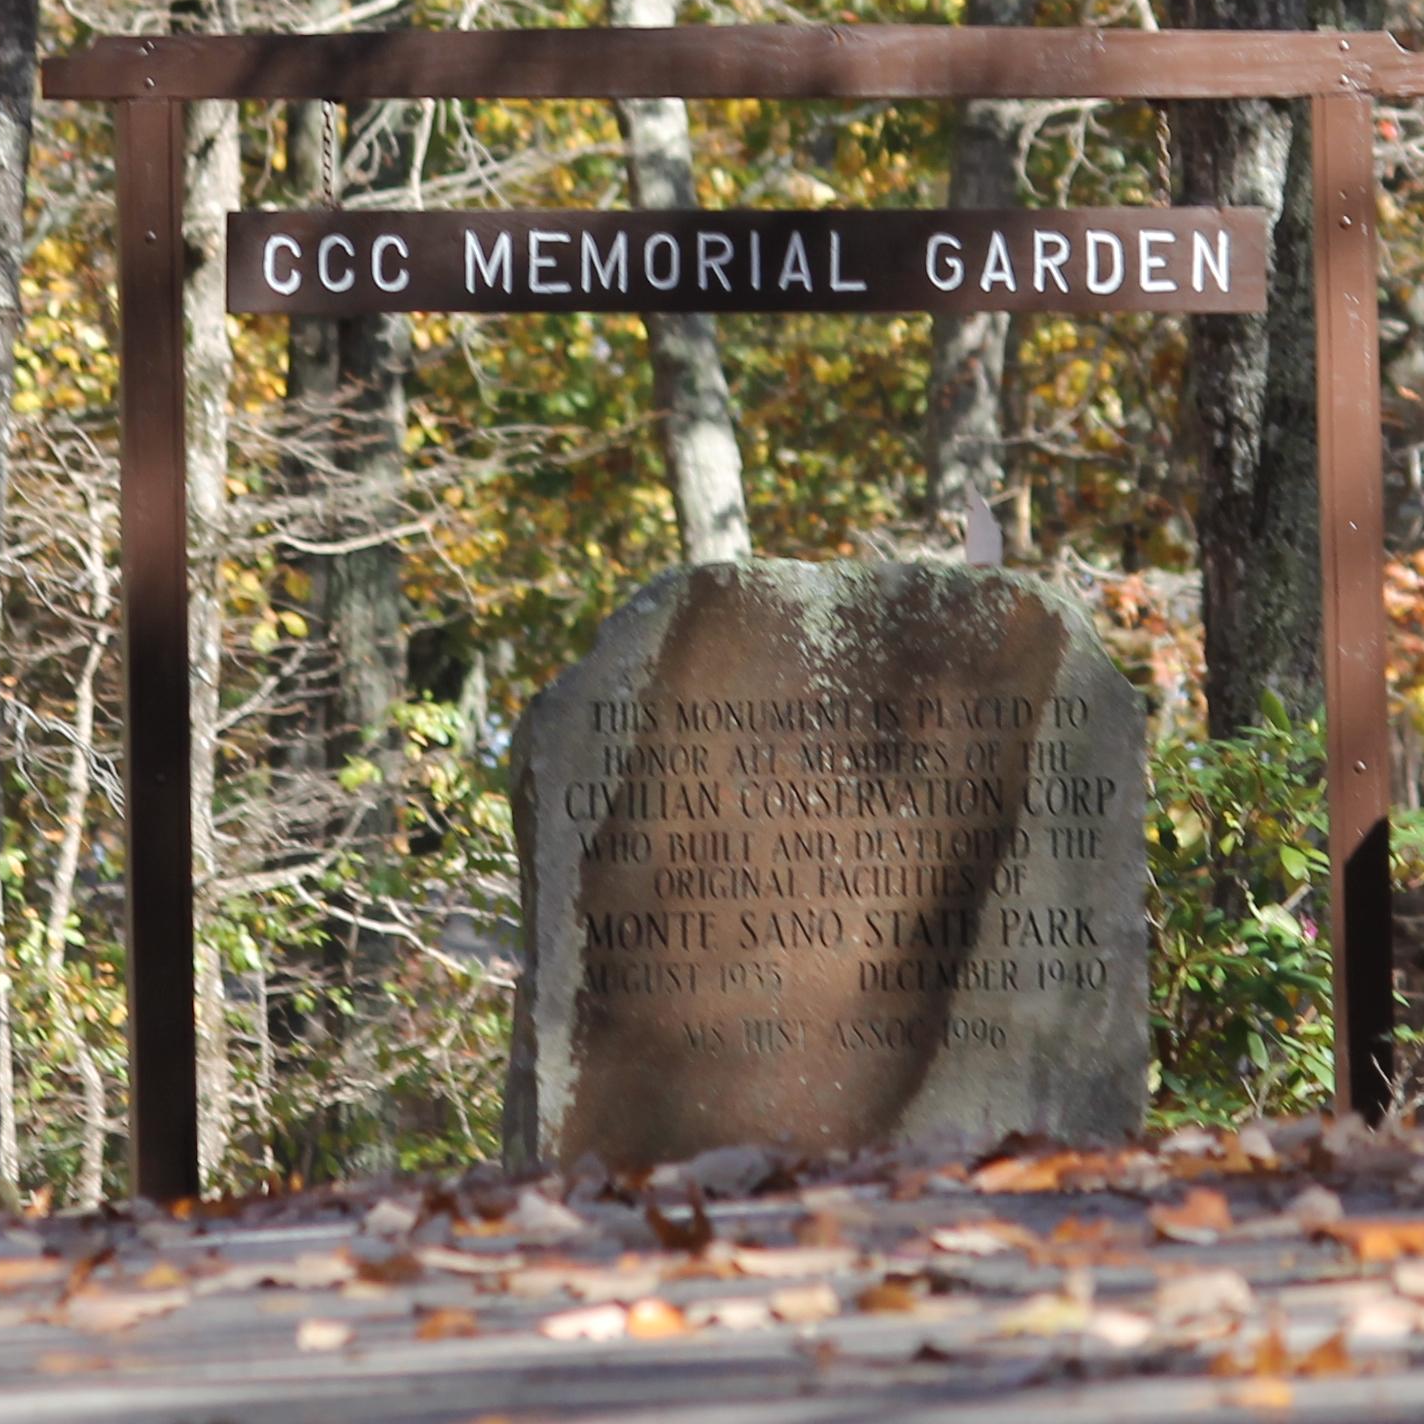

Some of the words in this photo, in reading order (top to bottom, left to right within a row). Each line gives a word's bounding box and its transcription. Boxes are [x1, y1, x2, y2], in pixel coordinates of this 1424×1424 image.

[263, 233, 410, 295] CCC
[463, 230, 868, 296] MEMORIAL
[925, 229, 1231, 295] GARDEN
[590, 697, 657, 733] THIS
[677, 696, 853, 733] MONUMENT
[875, 697, 900, 730] IS
[916, 695, 1034, 729] PLACED
[1053, 695, 1089, 728] TO
[603, 742, 709, 775] HONOR
[732, 742, 776, 774] ALL
[799, 739, 949, 774] MEMBERS
[965, 739, 1002, 771] OF
[1022, 740, 1070, 772] THE
[564, 780, 722, 821] CIVILIAN
[740, 777, 1004, 821] CONSERVATION
[1023, 776, 1116, 817] CORP
[577, 831, 653, 865] WHO
[668, 830, 754, 863] BUILT
[774, 829, 839, 863] AND
[854, 827, 1032, 862] DEVELOPED
[1048, 826, 1104, 860] THE
[654, 865, 797, 900] ORIGINAL
[819, 864, 976, 898] FACILITIES
[991, 864, 1027, 897] OF
[583, 911, 717, 952] MONTE
[738, 909, 844, 950] SANO
[864, 907, 977, 949] STATE
[1001, 906, 1100, 947] PARK
[583, 961, 703, 995] AUGUST
[859, 958, 1020, 992] DECEMBER
[1037, 957, 1108, 990] 1940
[744, 1018, 810, 1052] HIST
[831, 1017, 923, 1052] ASSOC
[943, 1016, 1007, 1051] 1996
